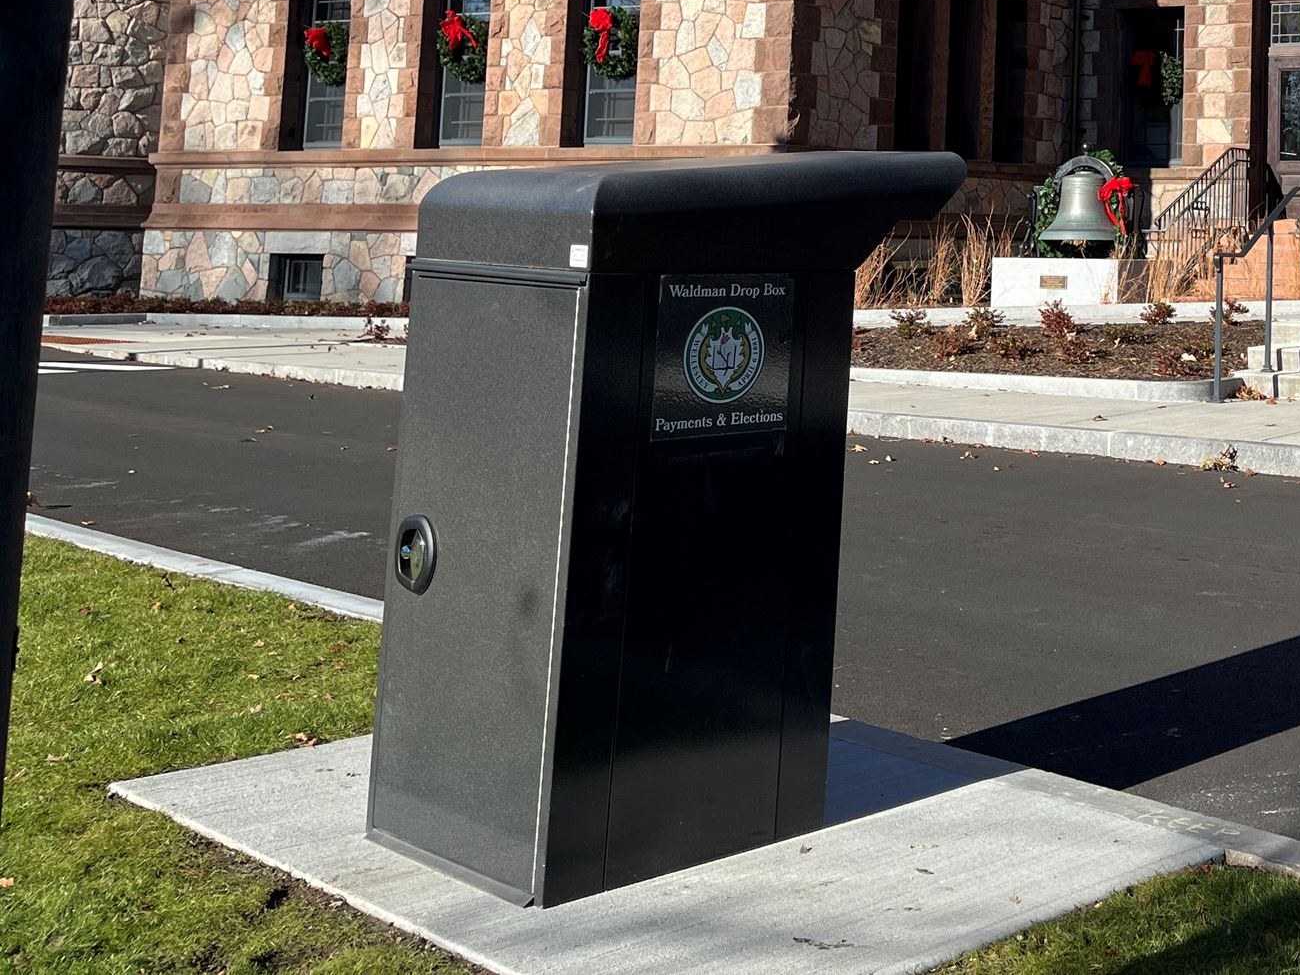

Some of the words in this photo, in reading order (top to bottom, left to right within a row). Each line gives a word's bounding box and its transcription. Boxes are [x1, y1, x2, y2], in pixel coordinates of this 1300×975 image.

[669, 284, 726, 298] Waldman
[730, 283, 760, 298] Drop
[763, 283, 786, 296] Box
[690, 339, 709, 389] WELLESLEY
[737, 366, 755, 388] APRIL
[751, 336, 759, 355] 1881
[655, 416, 713, 433] Payments
[716, 412, 727, 426] &
[730, 410, 783, 425] Elections
